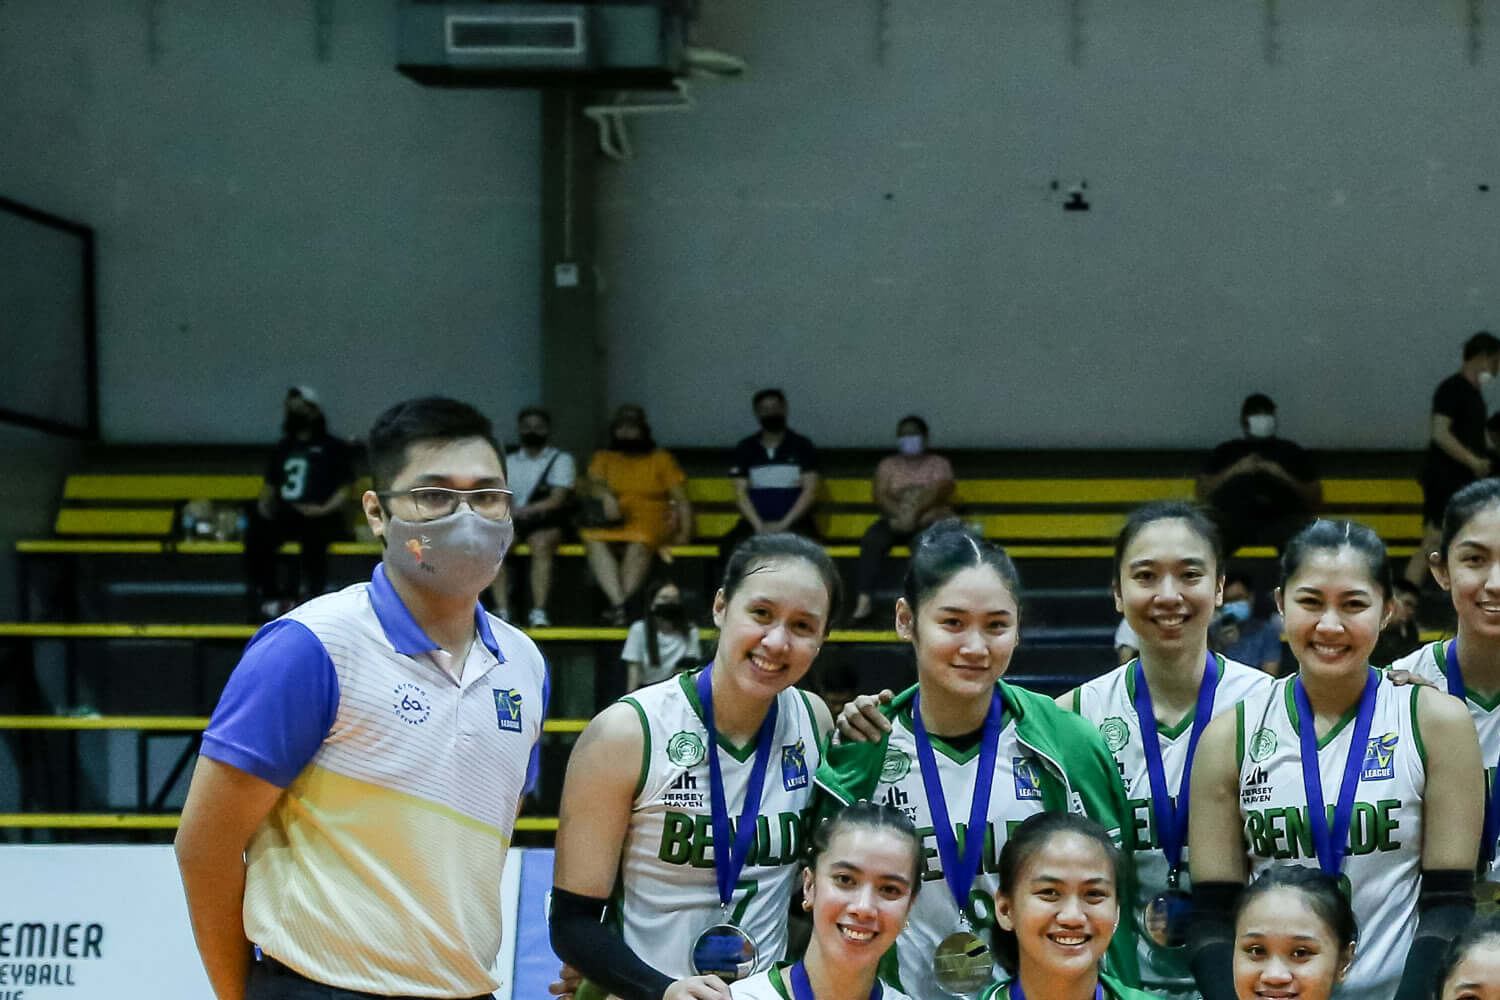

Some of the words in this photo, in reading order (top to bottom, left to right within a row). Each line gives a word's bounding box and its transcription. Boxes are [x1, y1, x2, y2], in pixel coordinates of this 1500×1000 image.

[282, 458, 307, 499] 3
[1364, 768, 1391, 778] LEAGUE
[661, 793, 704, 801] JERSEY
[663, 800, 704, 808] HAVEN
[728, 879, 759, 925] 7
